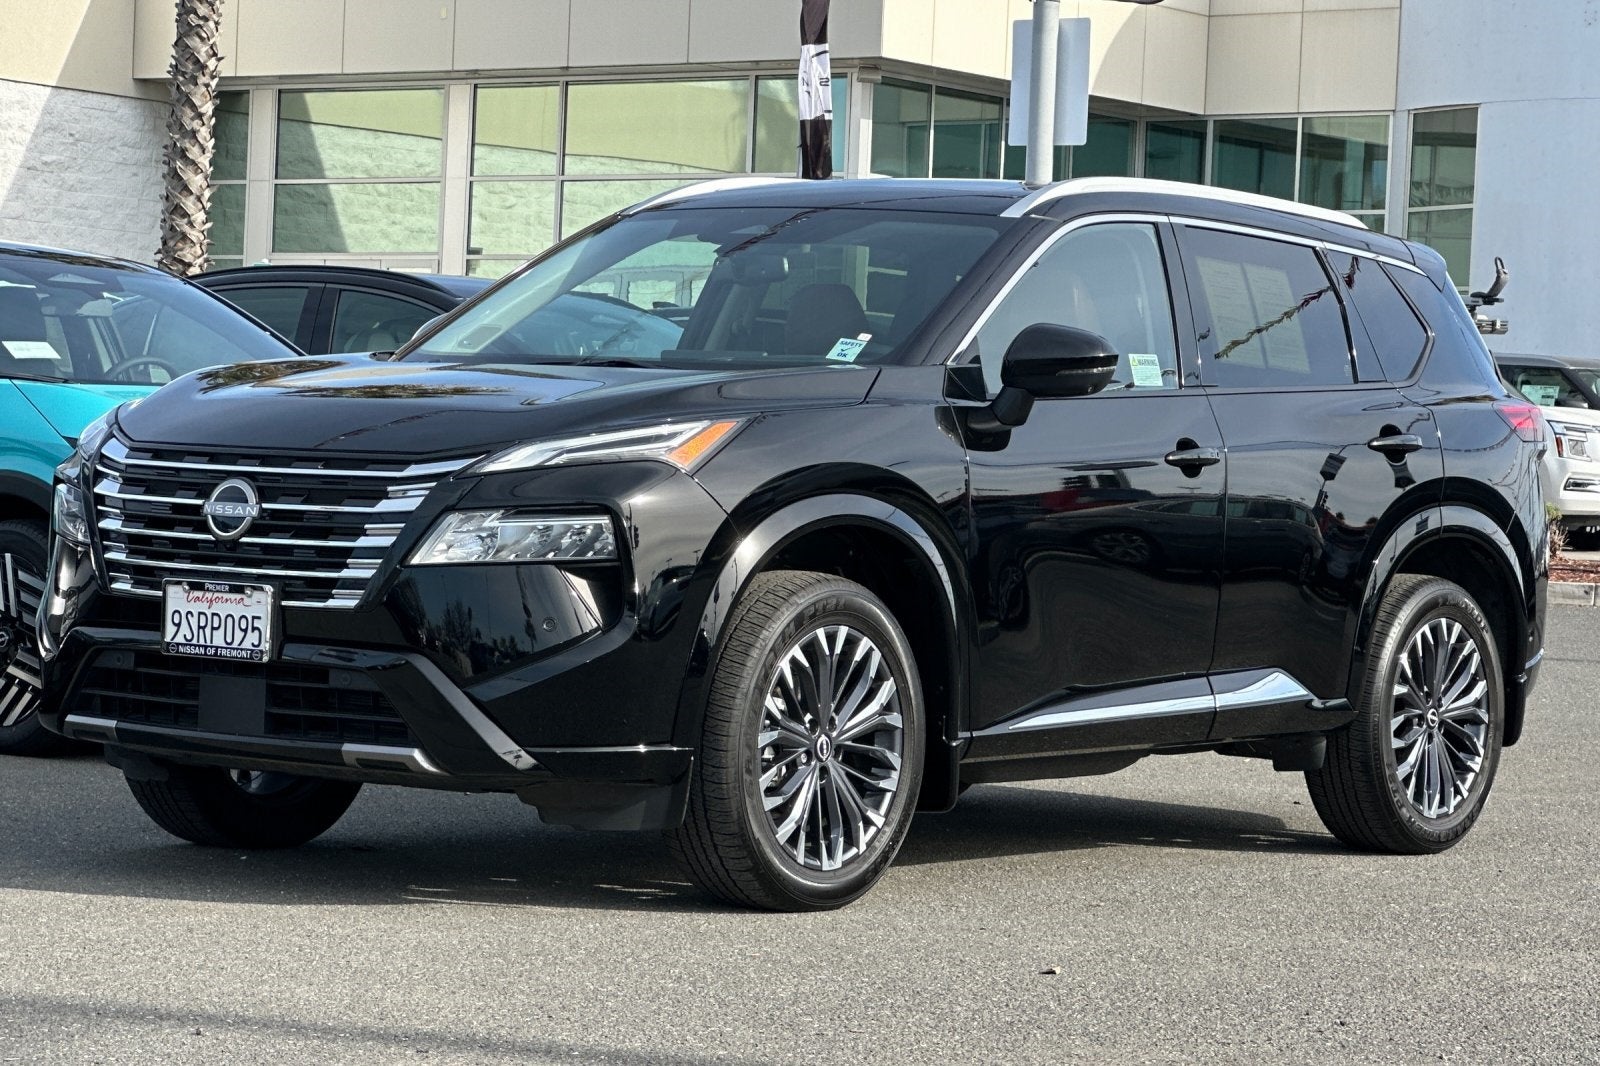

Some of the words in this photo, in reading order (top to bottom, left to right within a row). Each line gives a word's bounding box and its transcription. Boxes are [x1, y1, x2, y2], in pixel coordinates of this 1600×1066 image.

[204, 503, 257, 515] NISSAN
[204, 582, 230, 592] PREMIER
[186, 590, 252, 610] California
[170, 609, 263, 648] 9SRP095
[178, 645, 205, 655] NISSAN
[206, 647, 216, 656] OF
[217, 648, 251, 659] FREMONT
